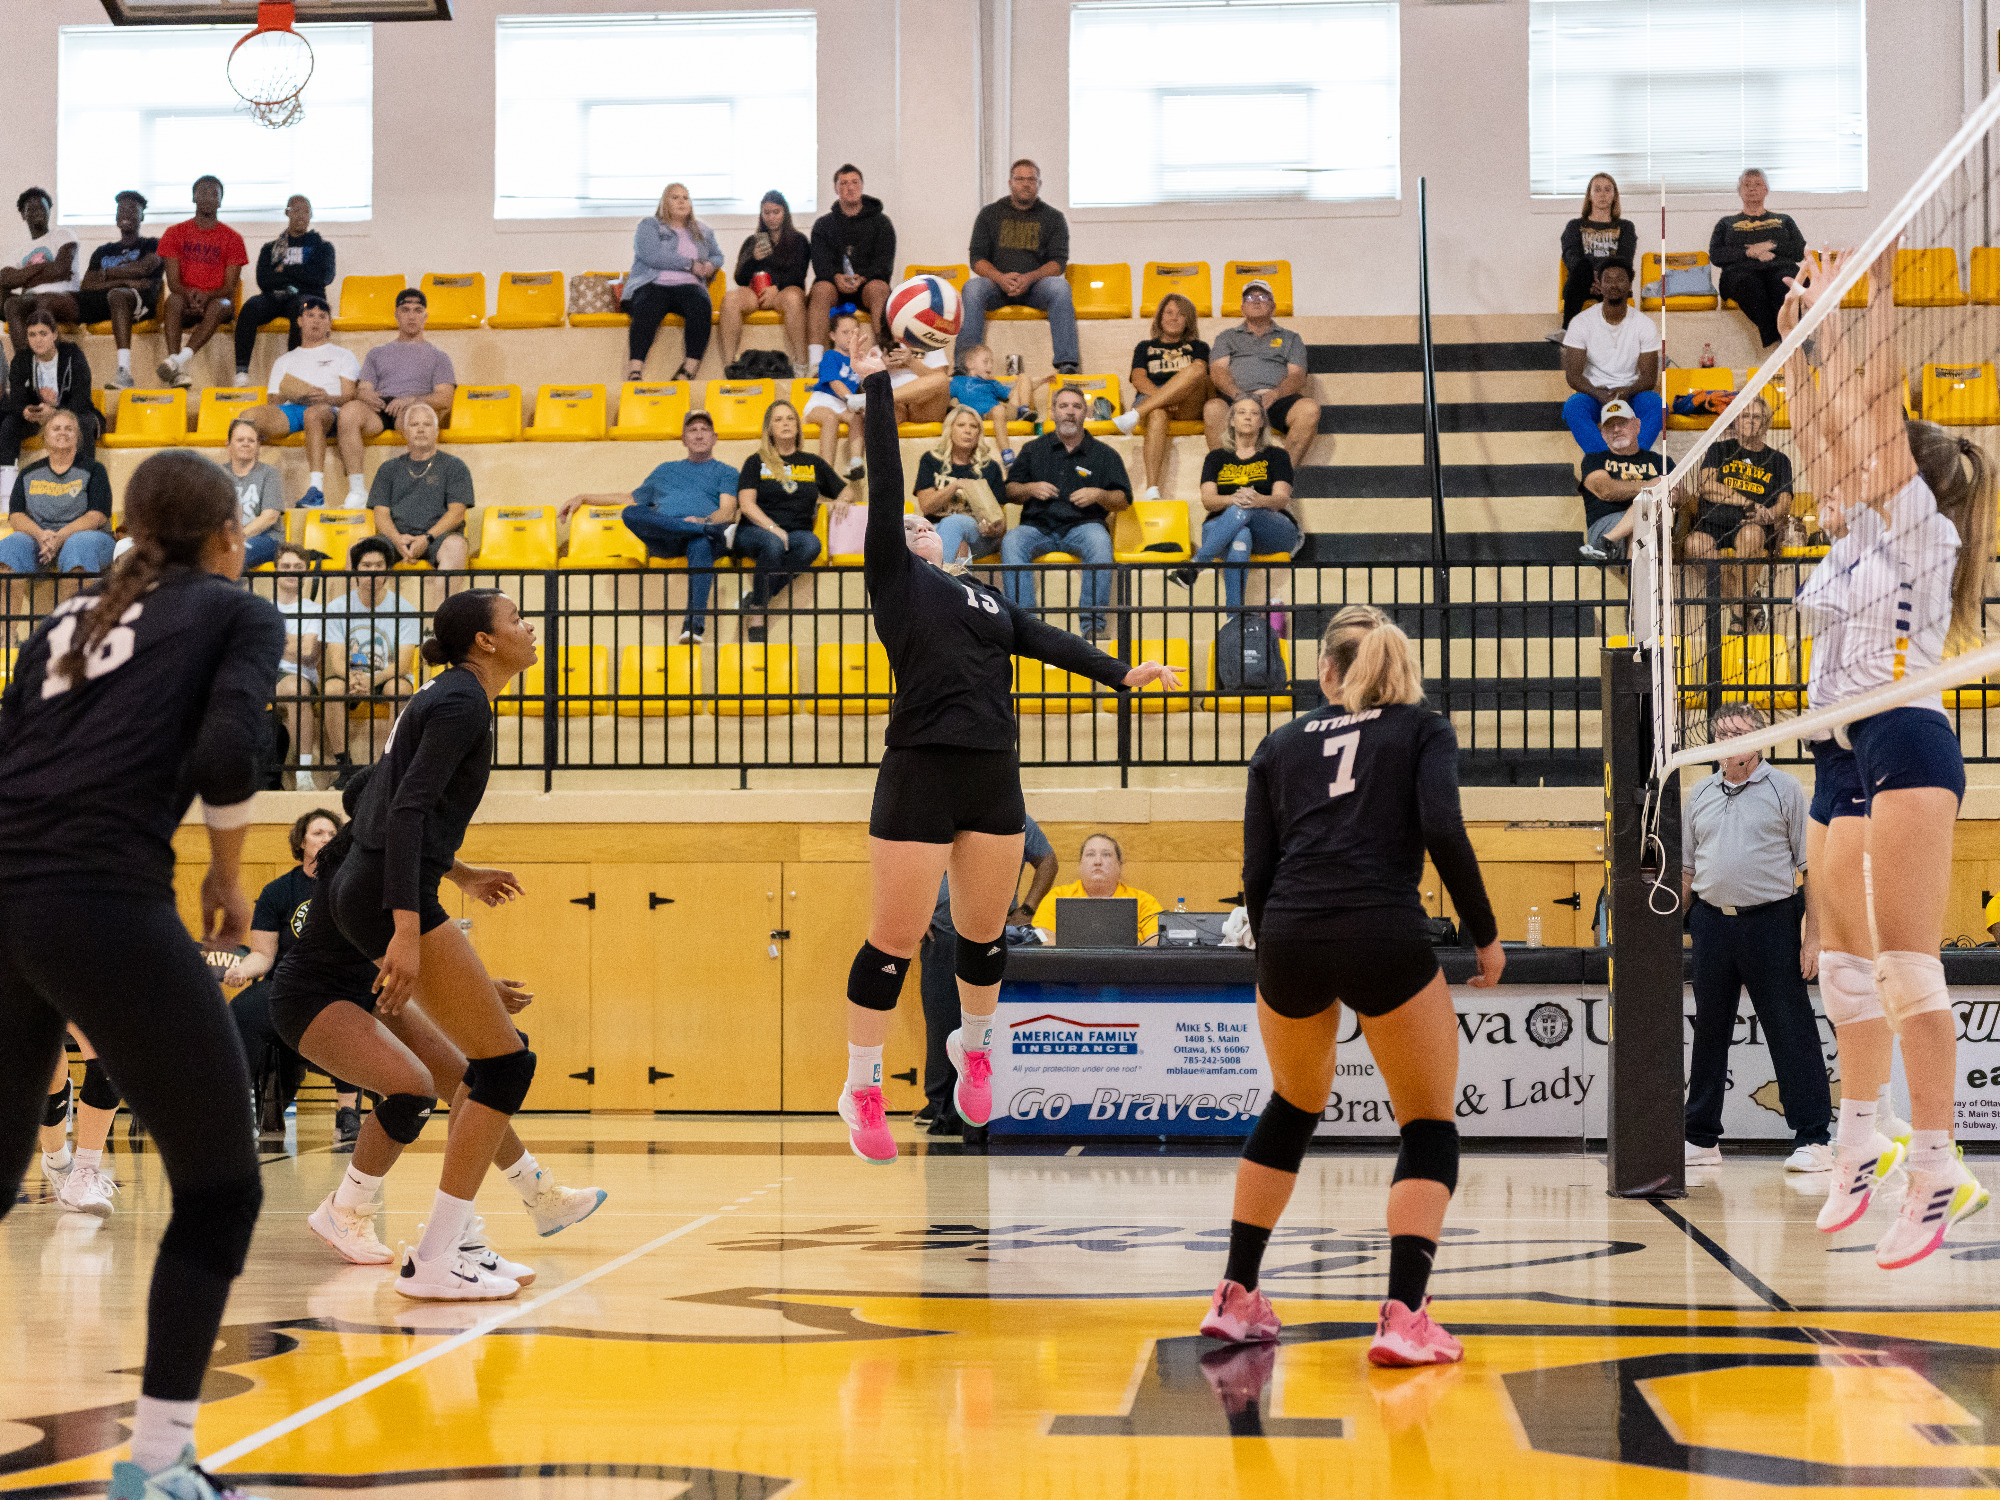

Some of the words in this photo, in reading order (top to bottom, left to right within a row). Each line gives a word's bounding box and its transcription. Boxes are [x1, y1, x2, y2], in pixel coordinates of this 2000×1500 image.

[1722, 460, 1773, 483] OTTAWA
[41, 602, 144, 700] 16
[1304, 708, 1383, 732] OTTAWA
[1323, 730, 1361, 798] 7
[200, 951, 241, 969] AWA
[1204, 1022, 1214, 1032] S.
[1951, 1001, 2000, 1042] SU
[1012, 1031, 1084, 1042] AMERICAN
[1089, 1031, 1137, 1042] FAMILY
[1021, 1044, 1128, 1053] INSURANCE
[1173, 1046, 1207, 1054] Ottawa,
[1183, 1056, 1241, 1064] 785-242-5008
[1042, 1065, 1080, 1073] protection
[1166, 1066, 1258, 1075] mblaue@amfam.com
[1335, 1064, 1374, 1076] ome
[1455, 1084, 1488, 1117] &
[1501, 1066, 1595, 1111] Lady
[1008, 1088, 1072, 1121] Go
[1087, 1088, 1260, 1121] Braves!
[1963, 1121, 1998, 1130] Subway,
